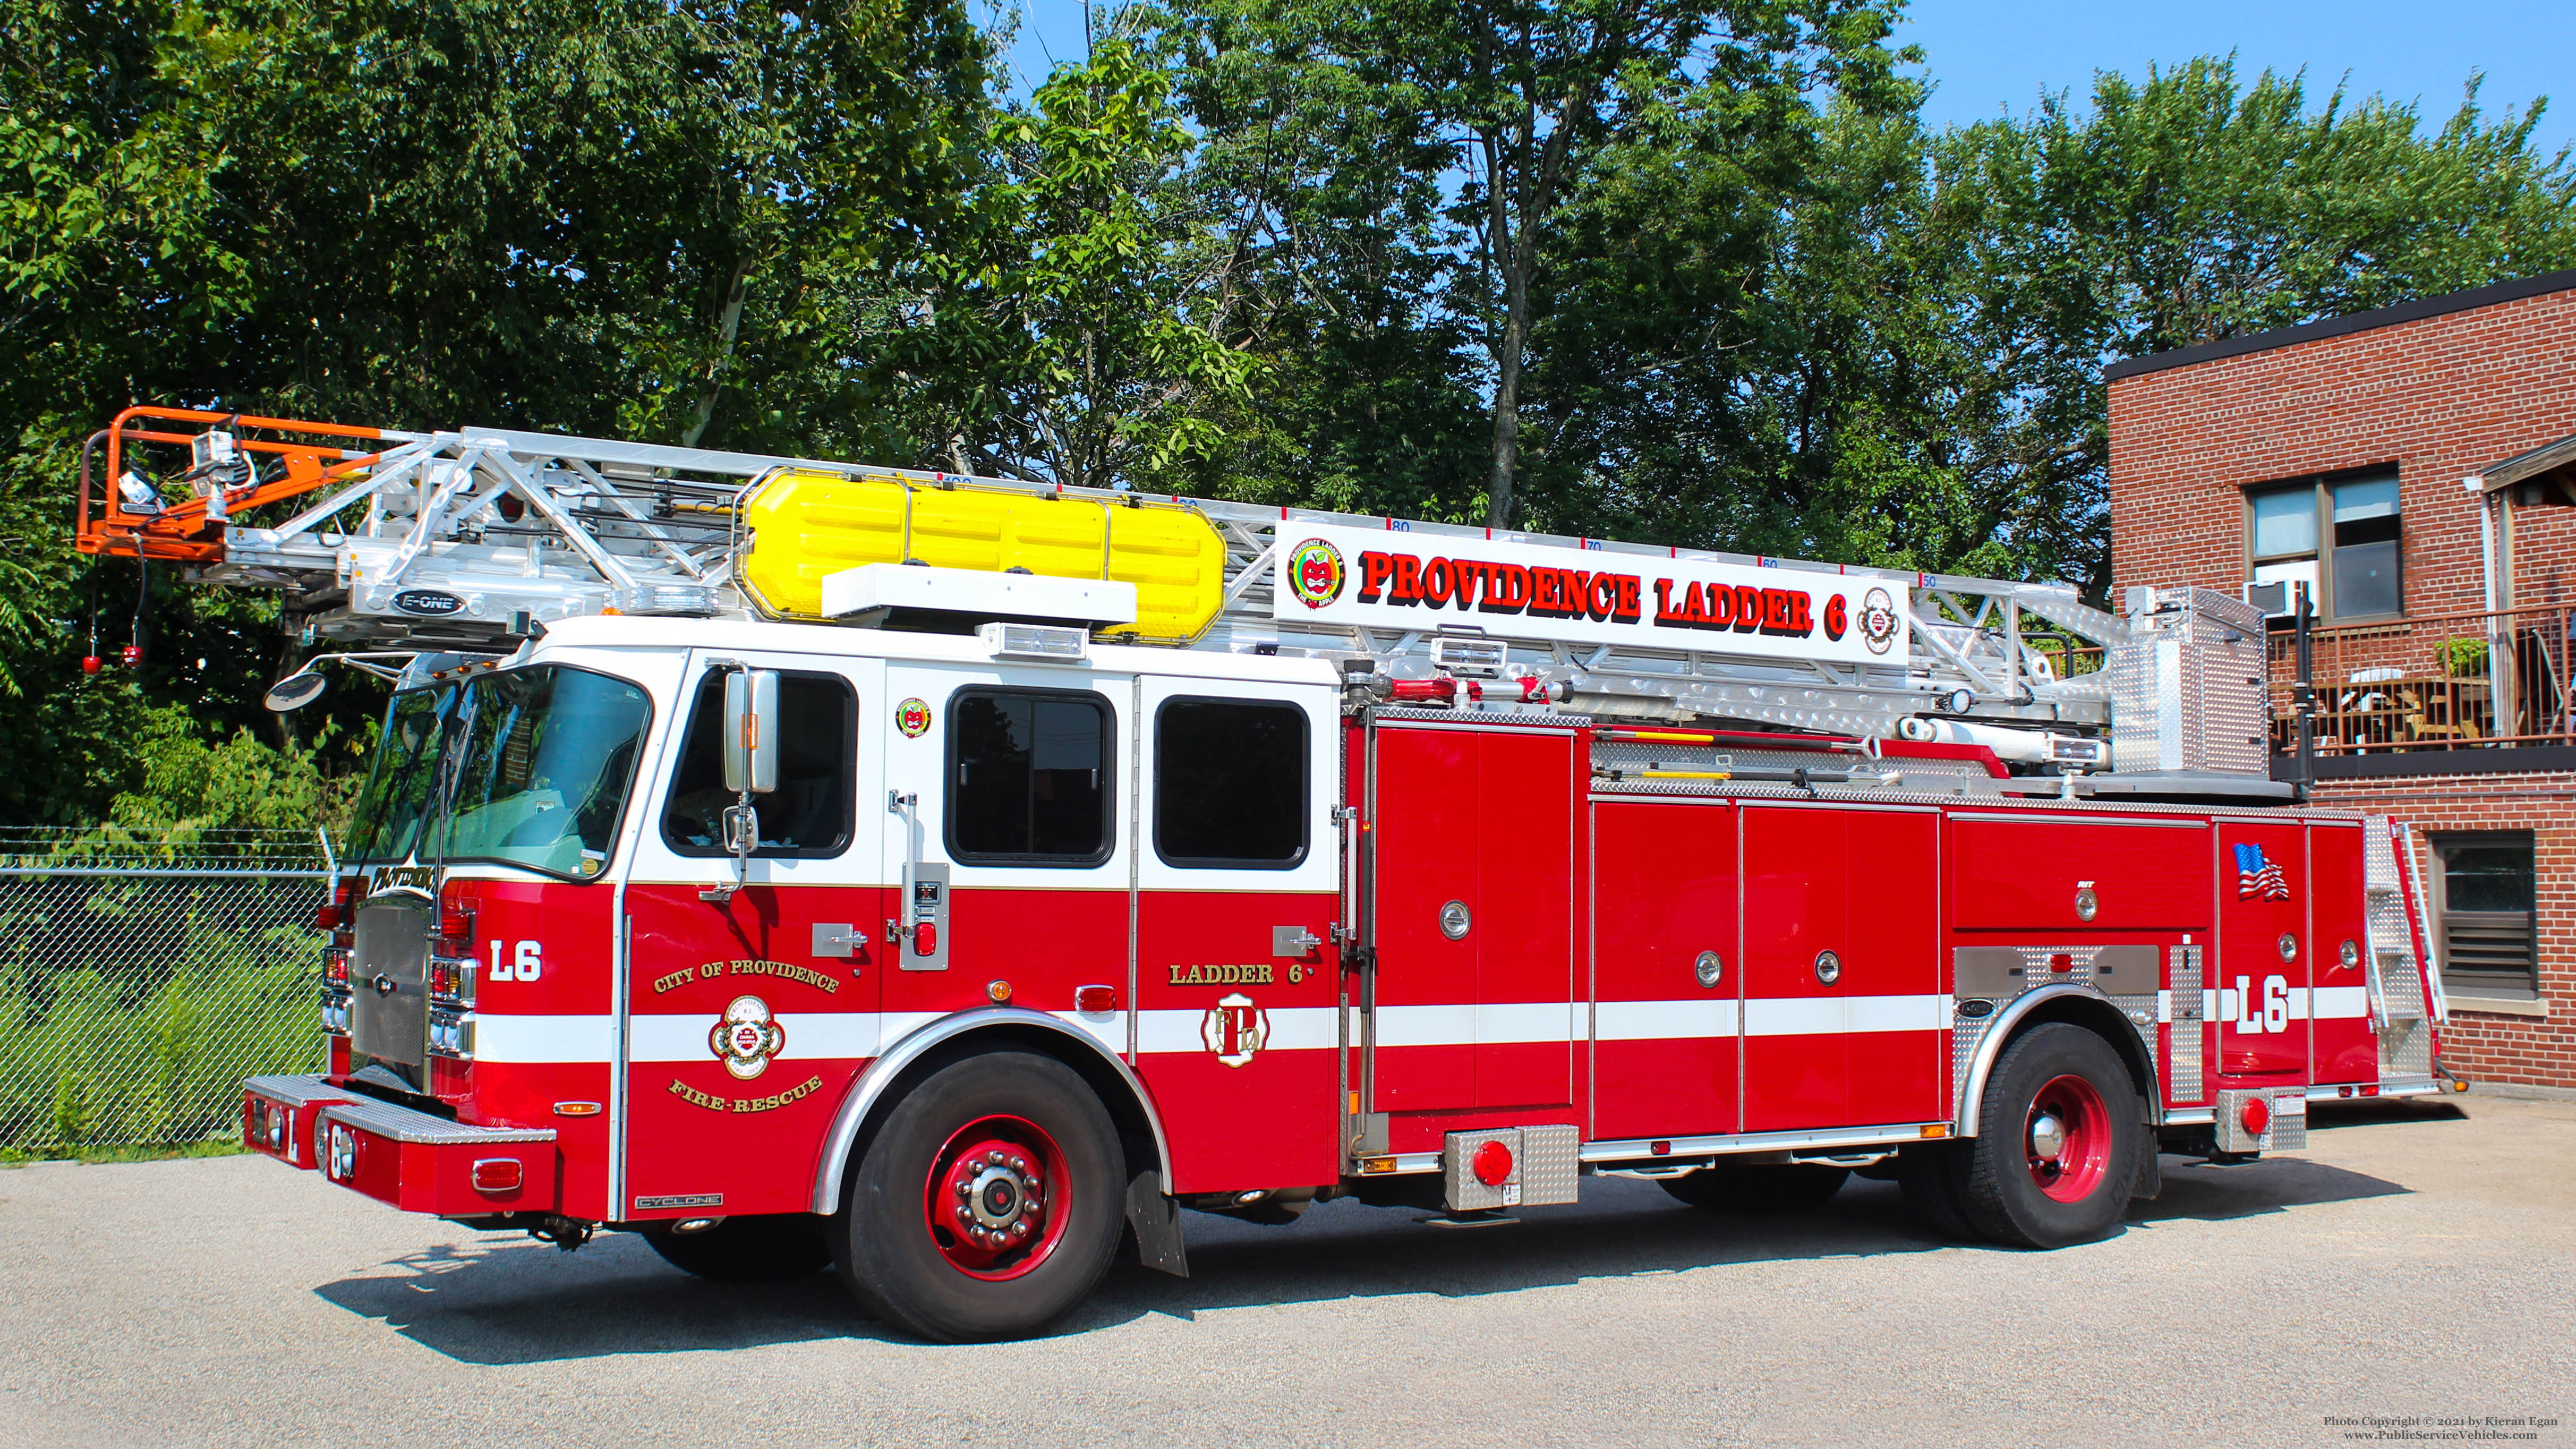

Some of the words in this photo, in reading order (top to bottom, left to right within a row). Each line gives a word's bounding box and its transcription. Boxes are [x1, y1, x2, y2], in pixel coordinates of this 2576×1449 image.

[1392, 521, 1410, 532] 80
[1291, 540, 1320, 562] PROVIDENCE
[1321, 541, 1341, 560] LADDER
[1586, 541, 1601, 551] 70
[1924, 575, 1937, 587] 50
[402, 594, 455, 609] E-ONE
[1298, 592, 1308, 602] THE
[1318, 595, 1335, 607] APPLE
[1358, 551, 1641, 624] PROVIDENCE
[1653, 578, 1814, 639] LADDER
[1824, 593, 1848, 642] 6
[490, 940, 541, 982] L6
[654, 968, 694, 994] CITY
[701, 962, 724, 978] OF
[730, 960, 840, 994] PROVIDENCE
[1169, 965, 1274, 985] LADDER
[1288, 964, 1303, 984] 6
[2236, 975, 2288, 1034] L6
[668, 1074, 823, 1113] FIRE-RESCUE
[639, 1196, 720, 1206] CYCLONE
